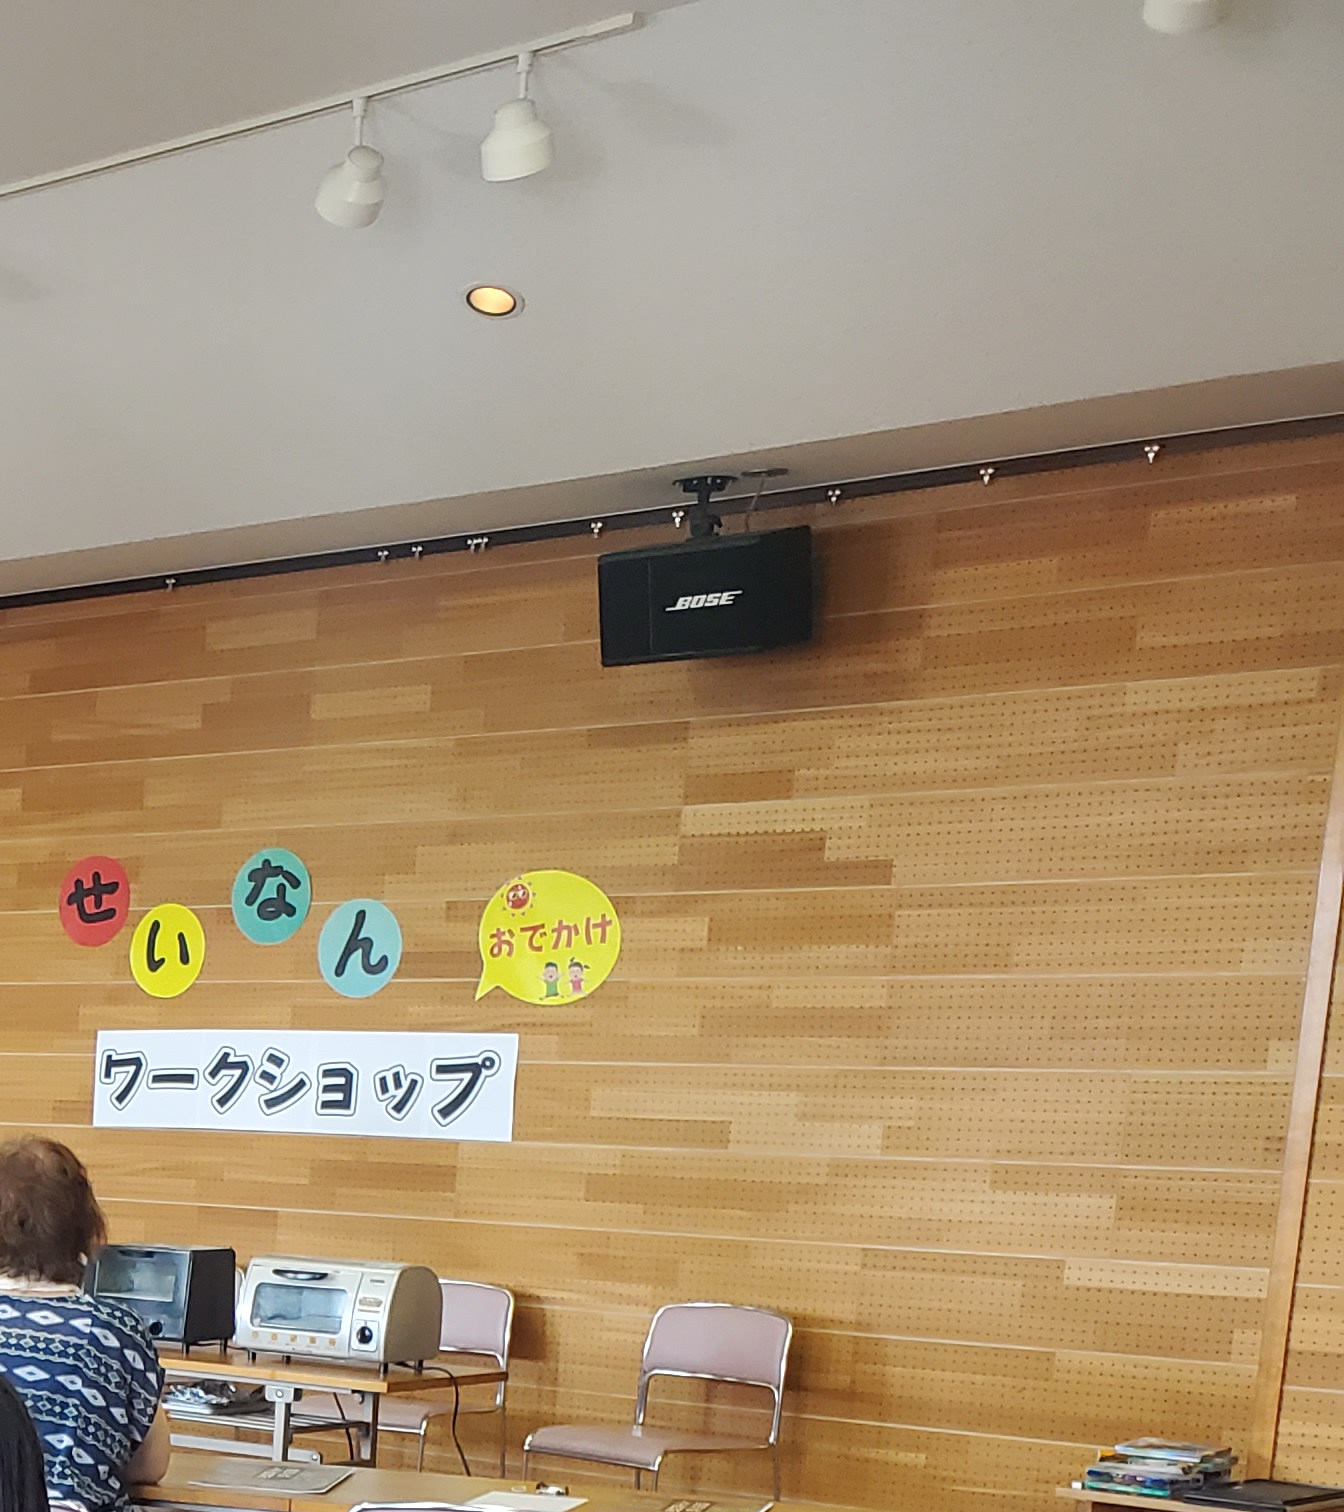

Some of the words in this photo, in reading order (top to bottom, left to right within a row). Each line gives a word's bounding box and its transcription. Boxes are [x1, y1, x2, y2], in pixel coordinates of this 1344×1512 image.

[665, 590, 743, 612] BOSE
[489, 913, 612, 958] おでかけ
[101, 1047, 501, 1127] ワークショップ
